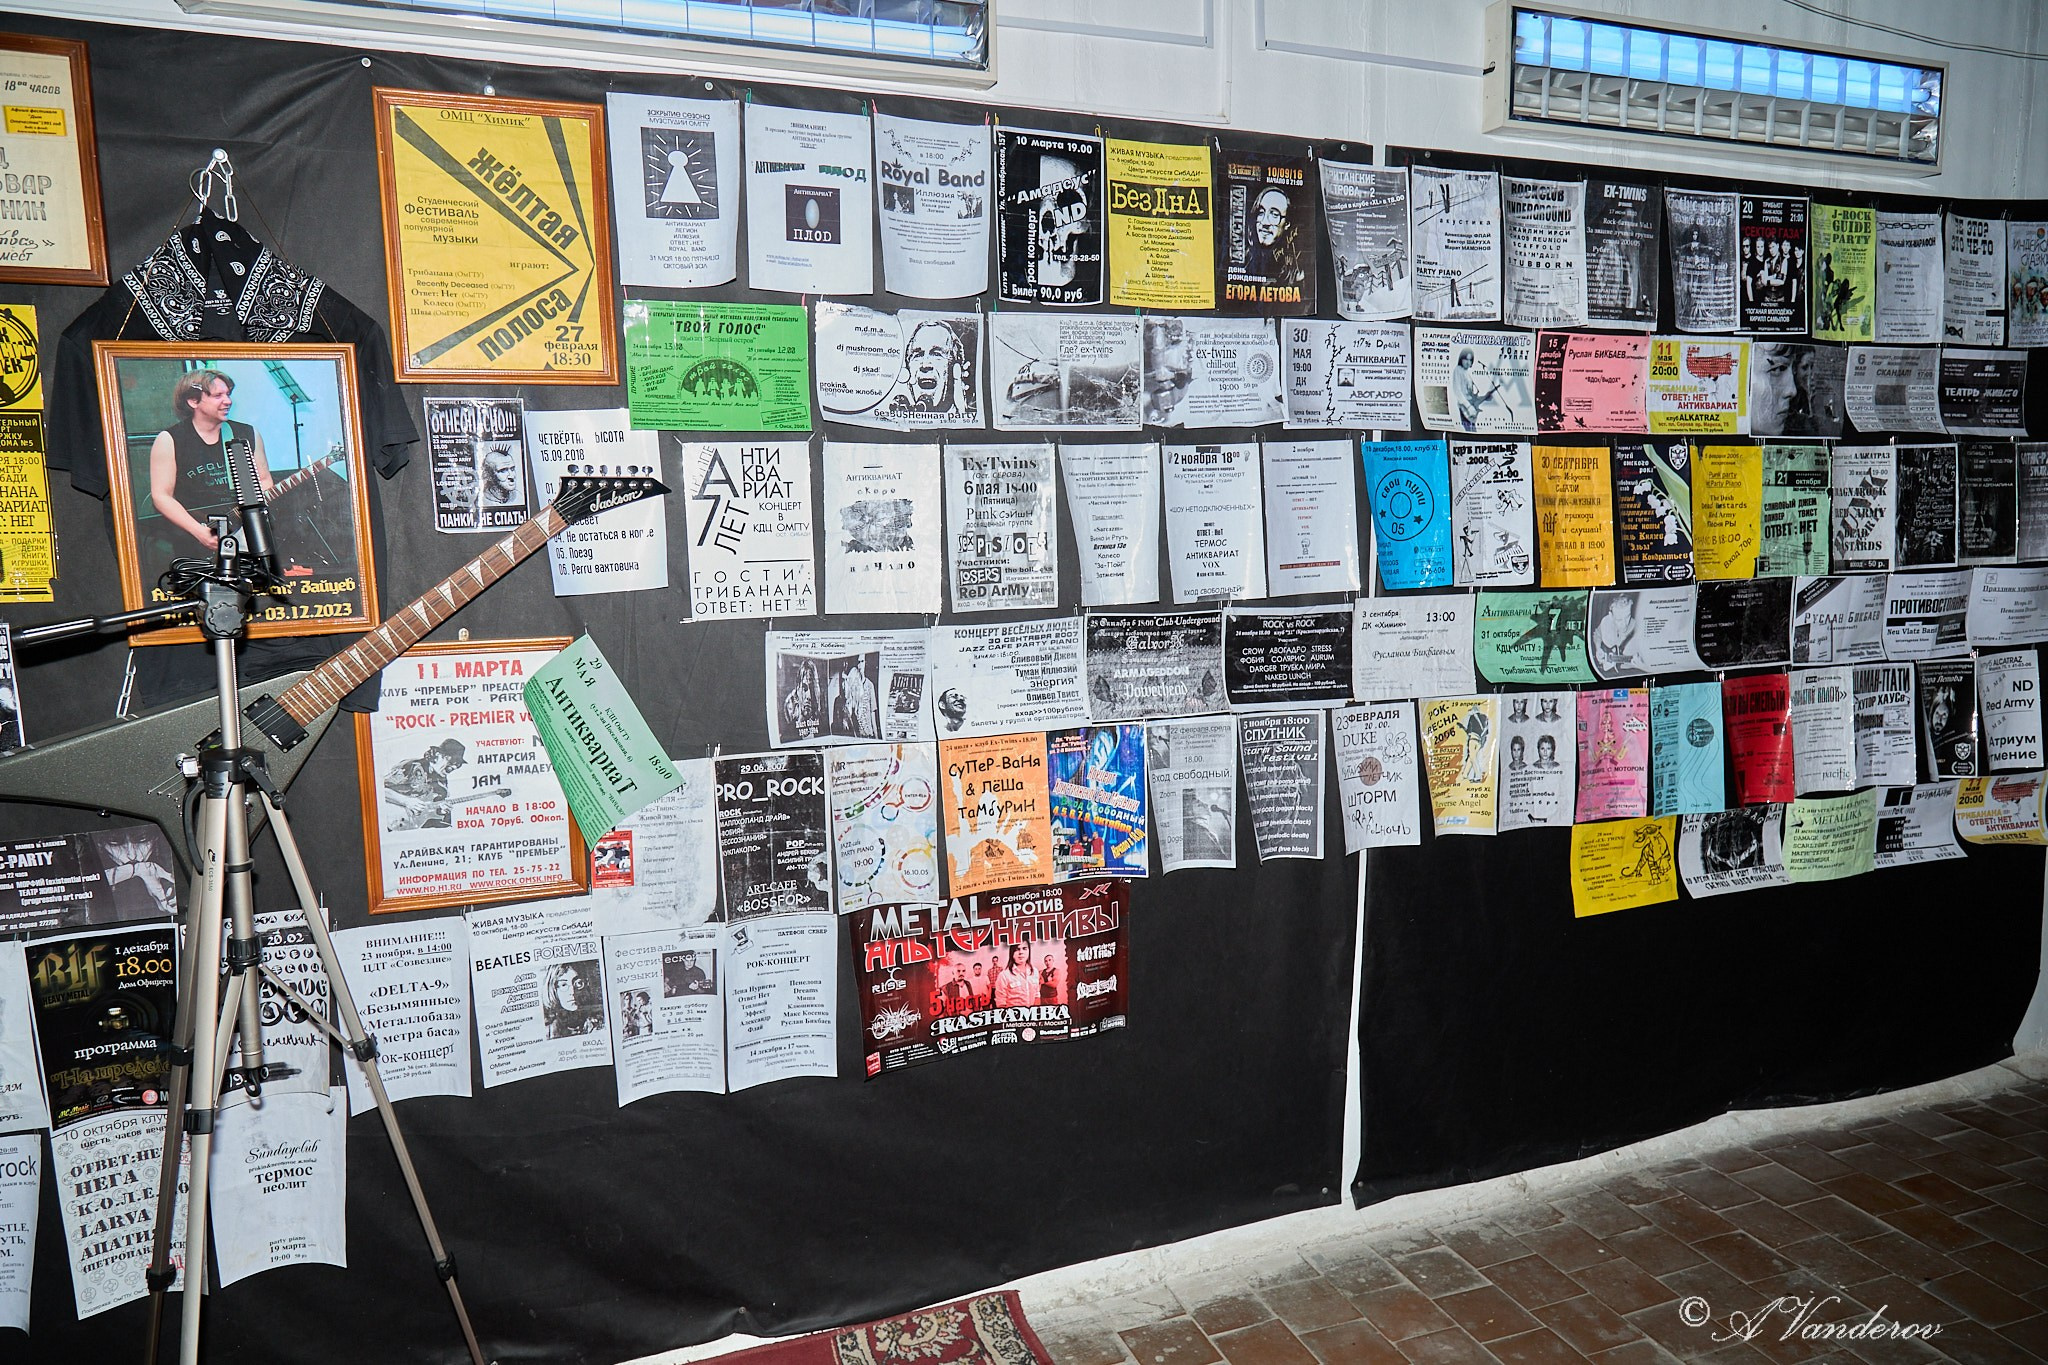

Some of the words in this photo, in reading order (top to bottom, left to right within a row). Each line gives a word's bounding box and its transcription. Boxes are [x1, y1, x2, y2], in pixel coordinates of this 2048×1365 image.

[29, 84, 61, 95] ЧАСОВ
[440, 110, 475, 123] ОМЦ
[1016, 136, 1027, 146] 10
[1030, 138, 1064, 151] марта
[1067, 141, 1092, 154] 19.00
[1110, 147, 1134, 157] ЖИВАЯ
[1135, 150, 1165, 160] МУЗЫКА
[881, 158, 929, 187] Royal
[938, 169, 985, 188] Band
[1267, 167, 1303, 180] 10/09/16
[1289, 178, 1303, 186] 21:00
[915, 189, 955, 199] Иллюзия
[1604, 184, 1647, 201] EX-TWINS
[417, 195, 479, 208] Студенческий
[1743, 201, 1753, 214] 20
[404, 202, 479, 218] Фестиваль
[1054, 202, 1088, 228] ND
[1832, 209, 1872, 221] J-ROCK
[420, 217, 478, 226] современной
[1790, 214, 1804, 222] 21:00
[404, 224, 454, 233] популярной
[1028, 208, 1037, 259] концерт
[1832, 220, 1872, 234] GUIDE
[433, 233, 478, 244] музыки
[1832, 234, 1871, 245] PARTY
[1069, 254, 1100, 262] 28-28-50
[1416, 267, 1438, 275] PARTY
[1439, 268, 1462, 277] PIANO
[416, 279, 448, 289] Recently
[450, 280, 489, 289] Deceased
[1012, 283, 1037, 297] Билет
[1040, 286, 1061, 299] 90,0
[1064, 287, 1083, 301] руб
[1226, 284, 1257, 300] ЕГОРА
[1260, 284, 1300, 302] ЛЕТОВА
[555, 326, 585, 342] 27
[1293, 328, 1308, 343] 30
[545, 341, 598, 352] февраля
[1081, 345, 1114, 354] ex-twins
[1548, 339, 1558, 348] 15
[1658, 343, 1671, 355] 11
[552, 352, 591, 365] 18:30
[1196, 346, 1237, 359] ex-twins
[1293, 349, 1312, 359] МАЯ
[1206, 360, 1236, 369] chill-out
[1293, 363, 1311, 372] 19:00
[1652, 366, 1678, 376] 20:00
[1295, 376, 1307, 387] ДК
[1662, 393, 1691, 401] ОТВЕТ:
[1693, 393, 1709, 401] НЕТ
[1678, 402, 1738, 410] АНТИКВАРИАТ
[947, 409, 977, 420] party
[1680, 414, 1720, 422] ALKATRAZ
[540, 450, 585, 462] 15.09.2018
[1181, 452, 1217, 465] ноября
[1553, 456, 1598, 469] СЕНТЯБРЯ
[1853, 452, 1891, 460] АЛЬКАТРАЗ
[962, 456, 1037, 471] Ex-Twins
[1493, 470, 1519, 479] 21-00
[1777, 473, 1788, 485] 21
[976, 482, 1000, 495] мая
[1006, 482, 1037, 494] 18-00
[590, 490, 643, 511] Jackson
[759, 502, 802, 511] КОНЦЕРТ
[980, 497, 1018, 506] (Пятница)
[494, 510, 527, 526] СПАТЬ!
[753, 524, 772, 533] КДЦ
[1392, 522, 1405, 535] 05
[1195, 539, 1228, 548] ТЕРМОС
[569, 548, 593, 560] Поезд
[1186, 550, 1239, 560] АНТИКВАРИАТ
[1642, 552, 1688, 560] Кондратьев
[957, 559, 1010, 567] Участники:
[1202, 561, 1220, 569] VOX
[694, 584, 812, 599] ТРИБАНАНА
[266, 603, 352, 620] 03.12.2023
[695, 602, 753, 614] ОТВЕТ:
[763, 599, 791, 612] НЕТ
[1426, 611, 1456, 622] 13:00
[954, 628, 998, 639] КОНЦЕРТ
[1001, 623, 1045, 636] ВЕСЁЛЫХ
[1492, 629, 1520, 639] октября
[1050, 637, 1079, 646] PIANO
[1011, 653, 1052, 665] Сливовый
[455, 659, 523, 678] МАРТА
[1015, 667, 1040, 678] Туман
[1041, 664, 1079, 675] Иллюзий
[1264, 673, 1286, 681] NAKED
[1288, 672, 1311, 680] LUNCH
[2013, 680, 2033, 692] ND
[410, 696, 439, 707] МЕГА
[446, 695, 470, 705] РОК
[1026, 691, 1055, 702] Оливер
[1056, 690, 1080, 700] Твист
[2004, 698, 2034, 711] Army
[1283, 716, 1310, 725] 18:00
[1348, 710, 1400, 722] ФЕВРАЛЯ
[1245, 726, 1305, 742] СПУТНИК
[1343, 732, 1377, 747] DUKE
[475, 738, 525, 748] УЧАСТВУЮТ:
[1989, 734, 2036, 748] Атриум
[477, 752, 536, 764] АНТАРСИЯ
[1822, 768, 1850, 781] pacific
[472, 774, 501, 789] JAM
[716, 777, 824, 802] PRO_ROCK
[1348, 790, 1396, 808] ШТОРМ
[1959, 795, 1984, 805] 20:00
[465, 805, 506, 815] НАЧАЛО
[525, 800, 555, 811] 18:00
[457, 817, 485, 829] ВХОД
[490, 815, 524, 826] 70руб.
[1812, 810, 1862, 825] METALLIKA
[513, 862, 561, 876] 25-75-22
[854, 858, 874, 868] 19:00
[746, 880, 797, 895] ART-CAFE
[1002, 891, 1040, 903] сентября
[1042, 888, 1063, 898] 18:00
[1001, 899, 1064, 918] ПРОТИВ
[871, 895, 990, 940] METAL
[365, 932, 446, 949] ВНИМАНИЕ!!!
[864, 901, 1120, 972] АЛЬТЕРНАТИВЫ
[124, 941, 169, 954] декабря
[426, 943, 452, 953] 14:00
[615, 944, 677, 958] Фестиваль
[475, 952, 531, 972] BEATLES
[533, 942, 597, 961] FOREVER
[746, 955, 811, 970] РОК-КОНЦЕРТ
[369, 981, 449, 998] «DELTA-9»
[359, 996, 461, 1017] «Безымянные»
[74, 1037, 158, 1059] программа
[83, 1117, 138, 1138] октября
[254, 1165, 313, 1184] термос
[263, 1180, 307, 1194] неолит
[79, 1209, 151, 1239] LARVA
